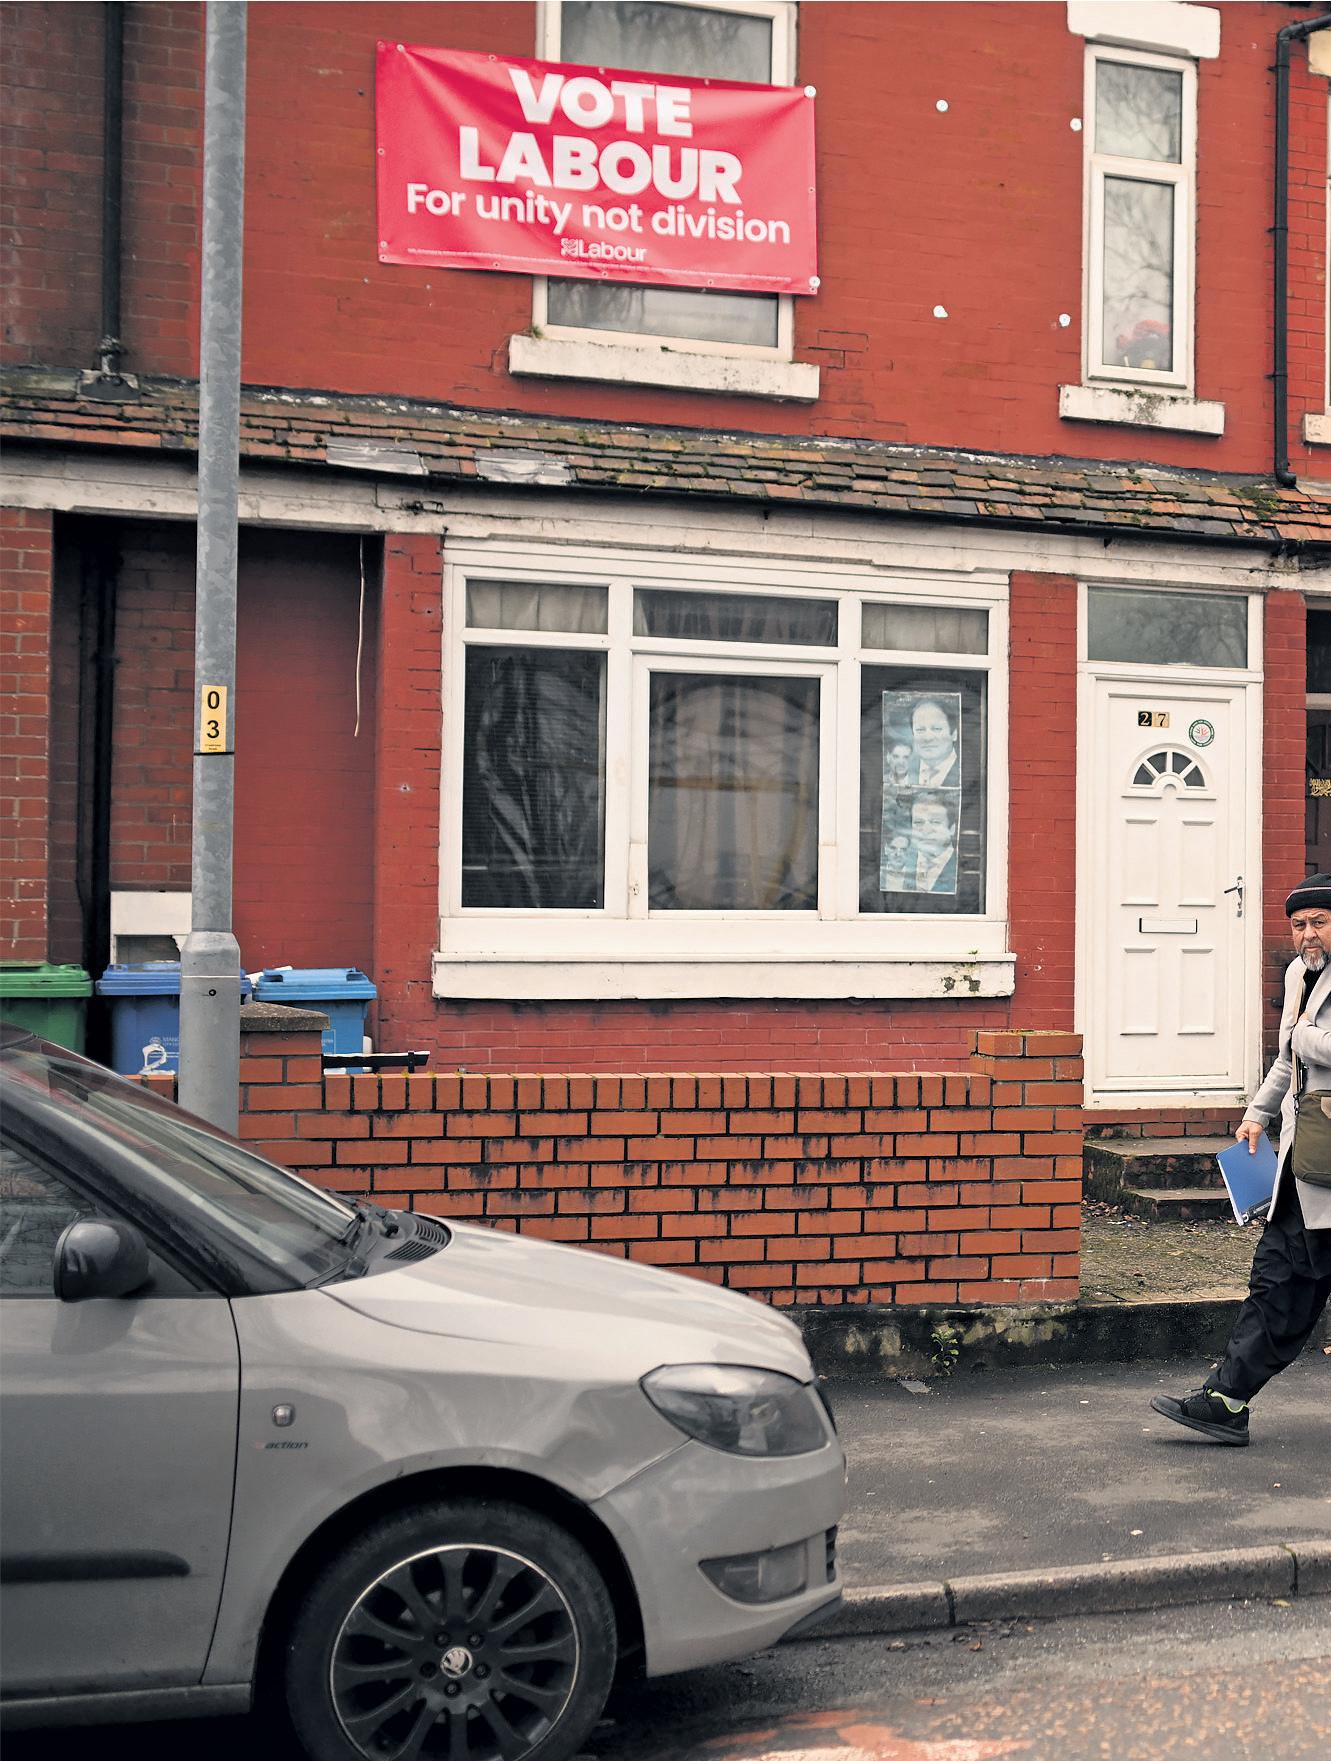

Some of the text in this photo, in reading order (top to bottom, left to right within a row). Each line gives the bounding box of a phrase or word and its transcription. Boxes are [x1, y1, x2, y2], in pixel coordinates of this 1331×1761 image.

[508, 68, 694, 138] VOTE
[459, 126, 743, 205] LABOUR
[407, 183, 791, 244] For unity not division
[578, 239, 647, 262] Labour
[1140, 712, 1167, 727] 27
